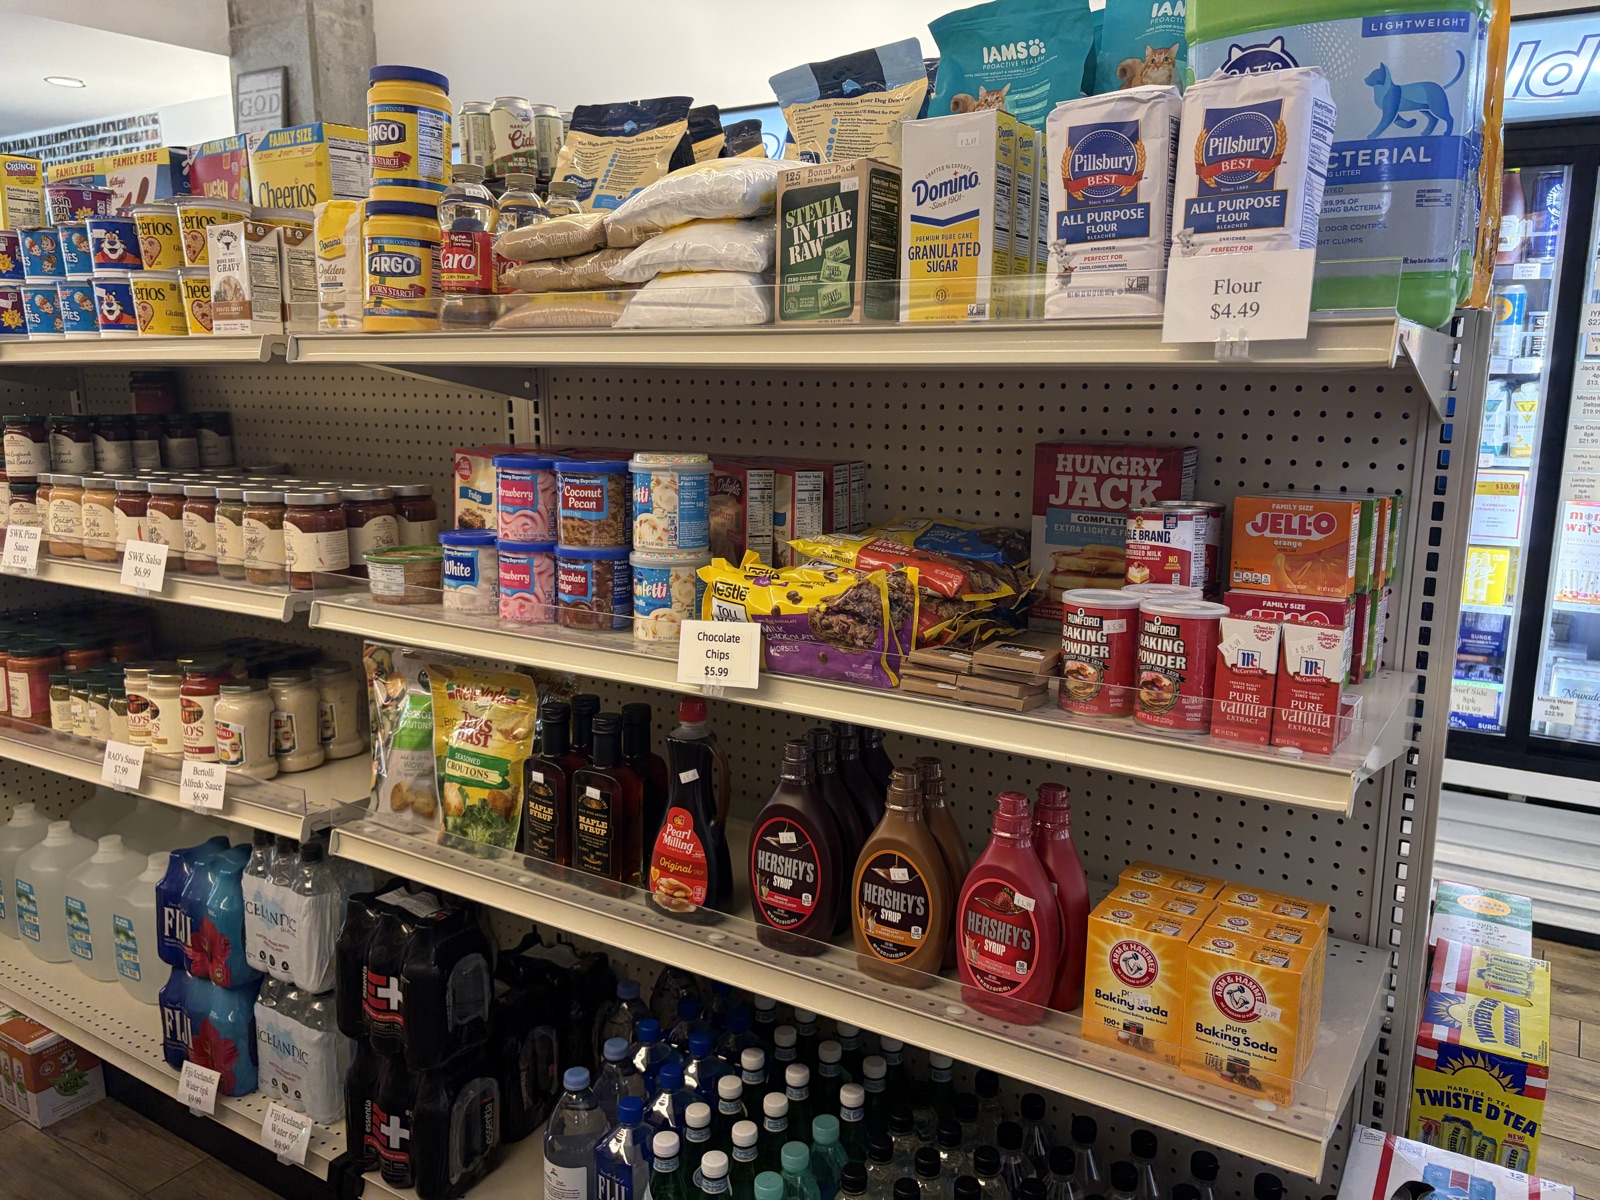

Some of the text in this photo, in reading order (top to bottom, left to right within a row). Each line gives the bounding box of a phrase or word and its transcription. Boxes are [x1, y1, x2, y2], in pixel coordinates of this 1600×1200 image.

[1370, 17, 1466, 32] LIGHTWEIGHT
[983, 42, 1028, 63] IAMS
[982, 60, 1019, 70] PROACTIVE
[240, 92, 280, 116] GOD
[268, 127, 313, 148] FAMILY SIZE
[1209, 132, 1274, 156] Pillsbury
[112, 152, 158, 168] FAMILY SIZE
[1074, 152, 1134, 173] Pillsbury
[1221, 157, 1255, 171] BEST
[56, 163, 95, 178] FAMILY SIZE
[785, 162, 856, 181] 125 Bonus Pack
[1333, 169, 1361, 177] LITTER
[1087, 174, 1118, 186] BEST
[258, 177, 316, 209] Cheerios
[911, 170, 979, 207] Domino
[1189, 195, 1281, 215] ALL PURPOSE
[1323, 199, 1346, 207] 99.9%
[1341, 204, 1382, 213] BACTERIA
[785, 195, 844, 229] STEVIA
[1061, 208, 1145, 227] ALL PURPOSE
[1216, 211, 1250, 223] FLOUR
[793, 210, 853, 246] IN THE
[1086, 222, 1118, 234] FLOUR
[1346, 222, 1388, 231] CONTROL
[915, 234, 940, 242] PREMIUM
[1332, 237, 1363, 245] CLUMPS
[788, 238, 824, 265] RAW
[908, 241, 981, 261] GRANULATED
[1084, 254, 1109, 262] PERFECT
[217, 263, 241, 273] GRAVY
[371, 255, 416, 273] ARGO
[926, 260, 959, 273] SUGAR
[1213, 278, 1262, 296] Flour
[1210, 301, 1260, 320] $4.49
[1056, 453, 1164, 477] HUNGRY
[1571, 477, 1585, 485] Lucky
[564, 485, 602, 499] Coconut
[1048, 474, 1162, 510] JACK
[568, 497, 596, 509] Pecan
[1271, 503, 1314, 512] FAMILY SIZE
[1077, 514, 1127, 526] COMPLETE
[9, 529, 38, 540] SWK Pizza
[1054, 523, 1110, 535] EXTRA LIGHT
[1139, 529, 1171, 543] BRAND
[1273, 539, 1303, 548] orange
[12, 555, 26, 565] $3.99
[128, 551, 161, 566] SWK Salsa
[1168, 555, 1178, 563] NO
[134, 566, 151, 578] $6.99
[445, 560, 471, 576] White
[1263, 601, 1306, 610] FAMILY SIZE
[1067, 613, 1100, 627] RUMFORD
[762, 624, 784, 634] MILK
[1063, 624, 1108, 644] BAKING
[1144, 621, 1177, 636] RUMFORD
[697, 631, 741, 644] Chocolate
[766, 632, 817, 641] CHOCOLATE
[1140, 634, 1184, 653] BAKING
[1470, 632, 1492, 641] SURGE
[705, 649, 730, 661] Chips
[1061, 639, 1110, 658] POWDER
[1139, 648, 1186, 669] POWDER
[704, 665, 729, 677] $5.99
[1153, 665, 1179, 677] SINCE 1859
[1232, 667, 1264, 675] McCormick
[1294, 675, 1327, 683] McCormick
[1228, 690, 1260, 704] PURE
[1469, 688, 1488, 697] Side
[1290, 700, 1324, 712] PURE
[1456, 703, 1481, 713] $19.99
[1537, 696, 1574, 706] Mom's Water
[1220, 700, 1267, 718] Vanilla
[1544, 709, 1564, 718] $22.99
[1226, 714, 1259, 725] EXTRACT
[1281, 708, 1331, 728] Vanilla
[1287, 723, 1322, 734] EXTRACT
[1478, 722, 1501, 732] SURGE
[107, 750, 140, 766] RAO's Sauce
[454, 752, 481, 765] SEASONED
[114, 766, 128, 775] $7.99
[193, 766, 214, 777] Bertolli
[447, 761, 489, 779] CROUTONS
[183, 778, 222, 791] Alfredo Sauce
[192, 792, 209, 802] $6.99
[528, 801, 554, 815] MAPLE
[529, 809, 553, 822] SYRUP
[578, 815, 608, 829] MAPLE
[579, 823, 607, 836] SYRUP
[666, 824, 691, 838] Pearl
[662, 833, 694, 853] Milling
[659, 857, 693, 875] Original
[757, 849, 815, 883] HERSHEY'S
[772, 875, 793, 891] SYRUP
[863, 881, 925, 916] HERSHEY'S
[243, 897, 297, 933] ICELANDIC
[880, 908, 902, 923] SYRUP
[163, 906, 192, 947] FIJI
[967, 910, 1031, 951] HERSHEY'S
[983, 939, 1006, 957] SYRUP
[1130, 943, 1155, 973] HAMMER
[162, 1006, 194, 1050] FIJI
[1225, 1023, 1247, 1034] pure
[1195, 1022, 1278, 1055] Baking Soda
[256, 1029, 309, 1065] ICELANDIC
[184, 1066, 216, 1086] Fiji/Icelandic
[1447, 1084, 1469, 1093] HARD
[1415, 1087, 1537, 1138] TWISTED TEA
[485, 1102, 493, 1145] essentia
[1508, 1132, 1525, 1142] NEW!
